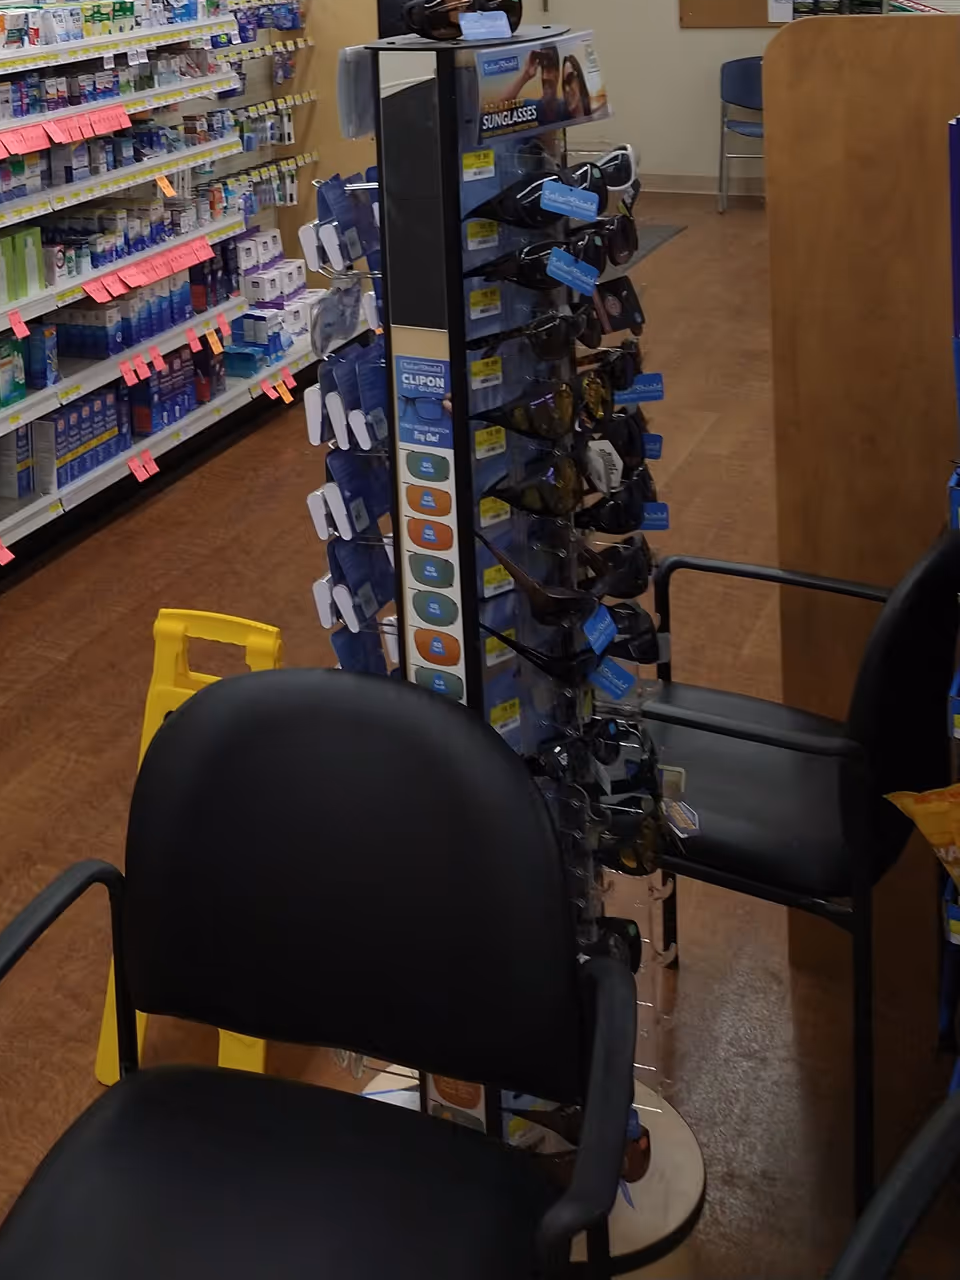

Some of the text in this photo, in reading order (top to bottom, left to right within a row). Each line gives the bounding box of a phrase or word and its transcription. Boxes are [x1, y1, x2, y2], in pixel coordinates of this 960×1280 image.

[482, 105, 538, 130] SUNGLASSES
[401, 373, 445, 388] CLIPON
[418, 385, 445, 393] GUIDE
